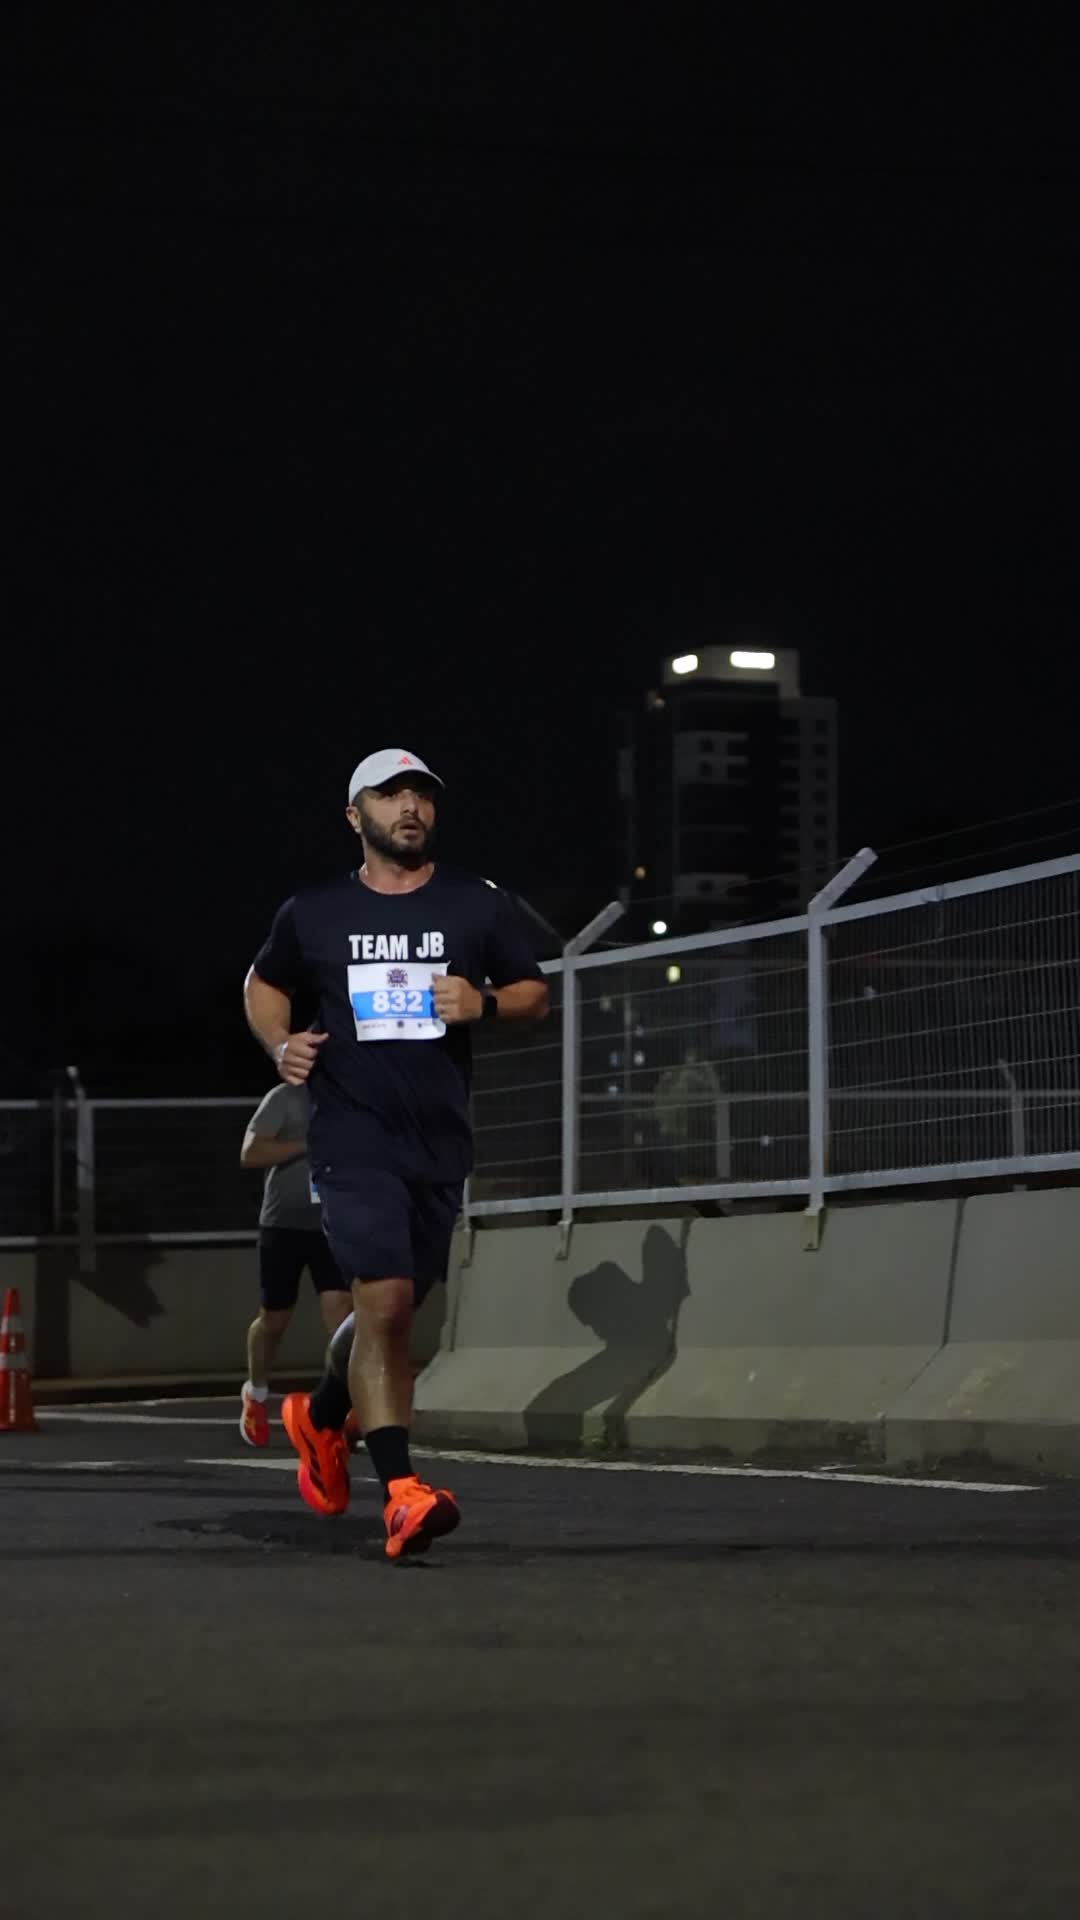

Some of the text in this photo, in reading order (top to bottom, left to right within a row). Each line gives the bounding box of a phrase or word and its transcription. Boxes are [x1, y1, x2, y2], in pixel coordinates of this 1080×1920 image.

[348, 931, 444, 960] TEAM JB
[373, 990, 423, 1012] 832
